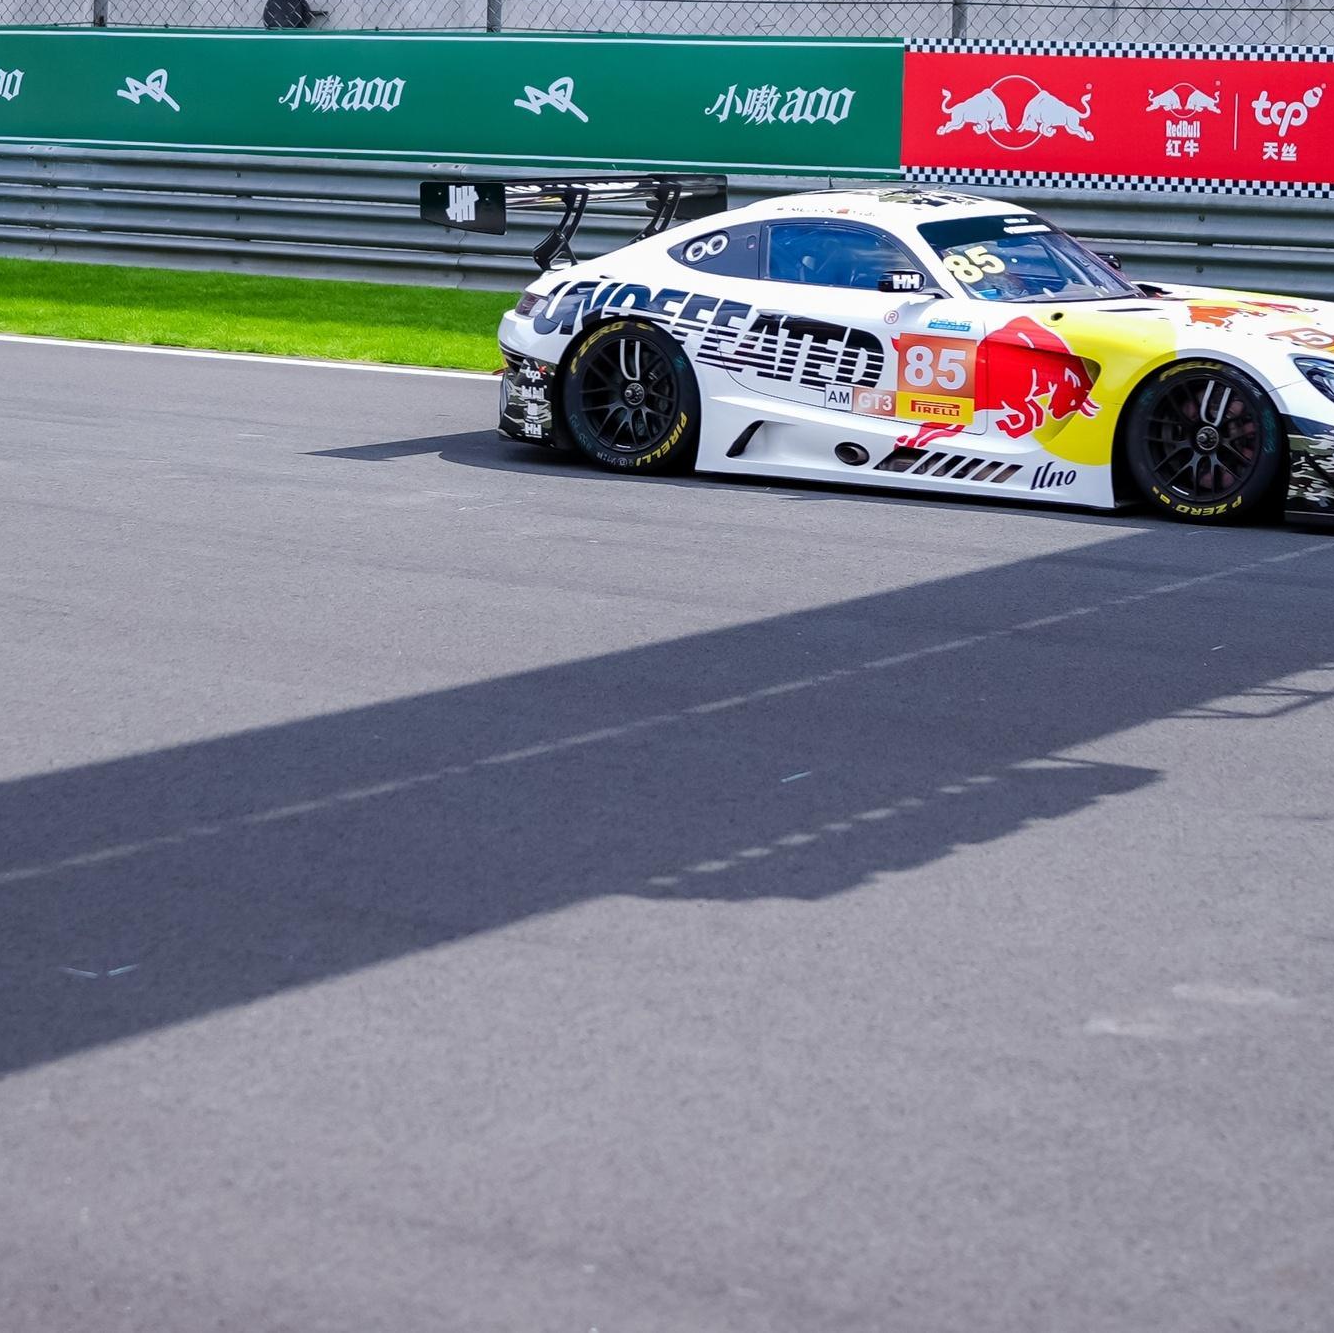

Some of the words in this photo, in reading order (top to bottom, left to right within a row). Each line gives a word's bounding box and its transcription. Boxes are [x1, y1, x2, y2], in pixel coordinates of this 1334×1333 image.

[1251, 90, 1309, 137] tcp
[1166, 140, 1200, 158] 红牛
[1263, 142, 1298, 162] 天丝
[943, 246, 1006, 283] 85
[903, 345, 967, 390] 85
[827, 389, 851, 408] AM
[857, 392, 893, 410] GT3
[910, 399, 961, 417] PIRELLI
[635, 411, 688, 466] PIRELLI
